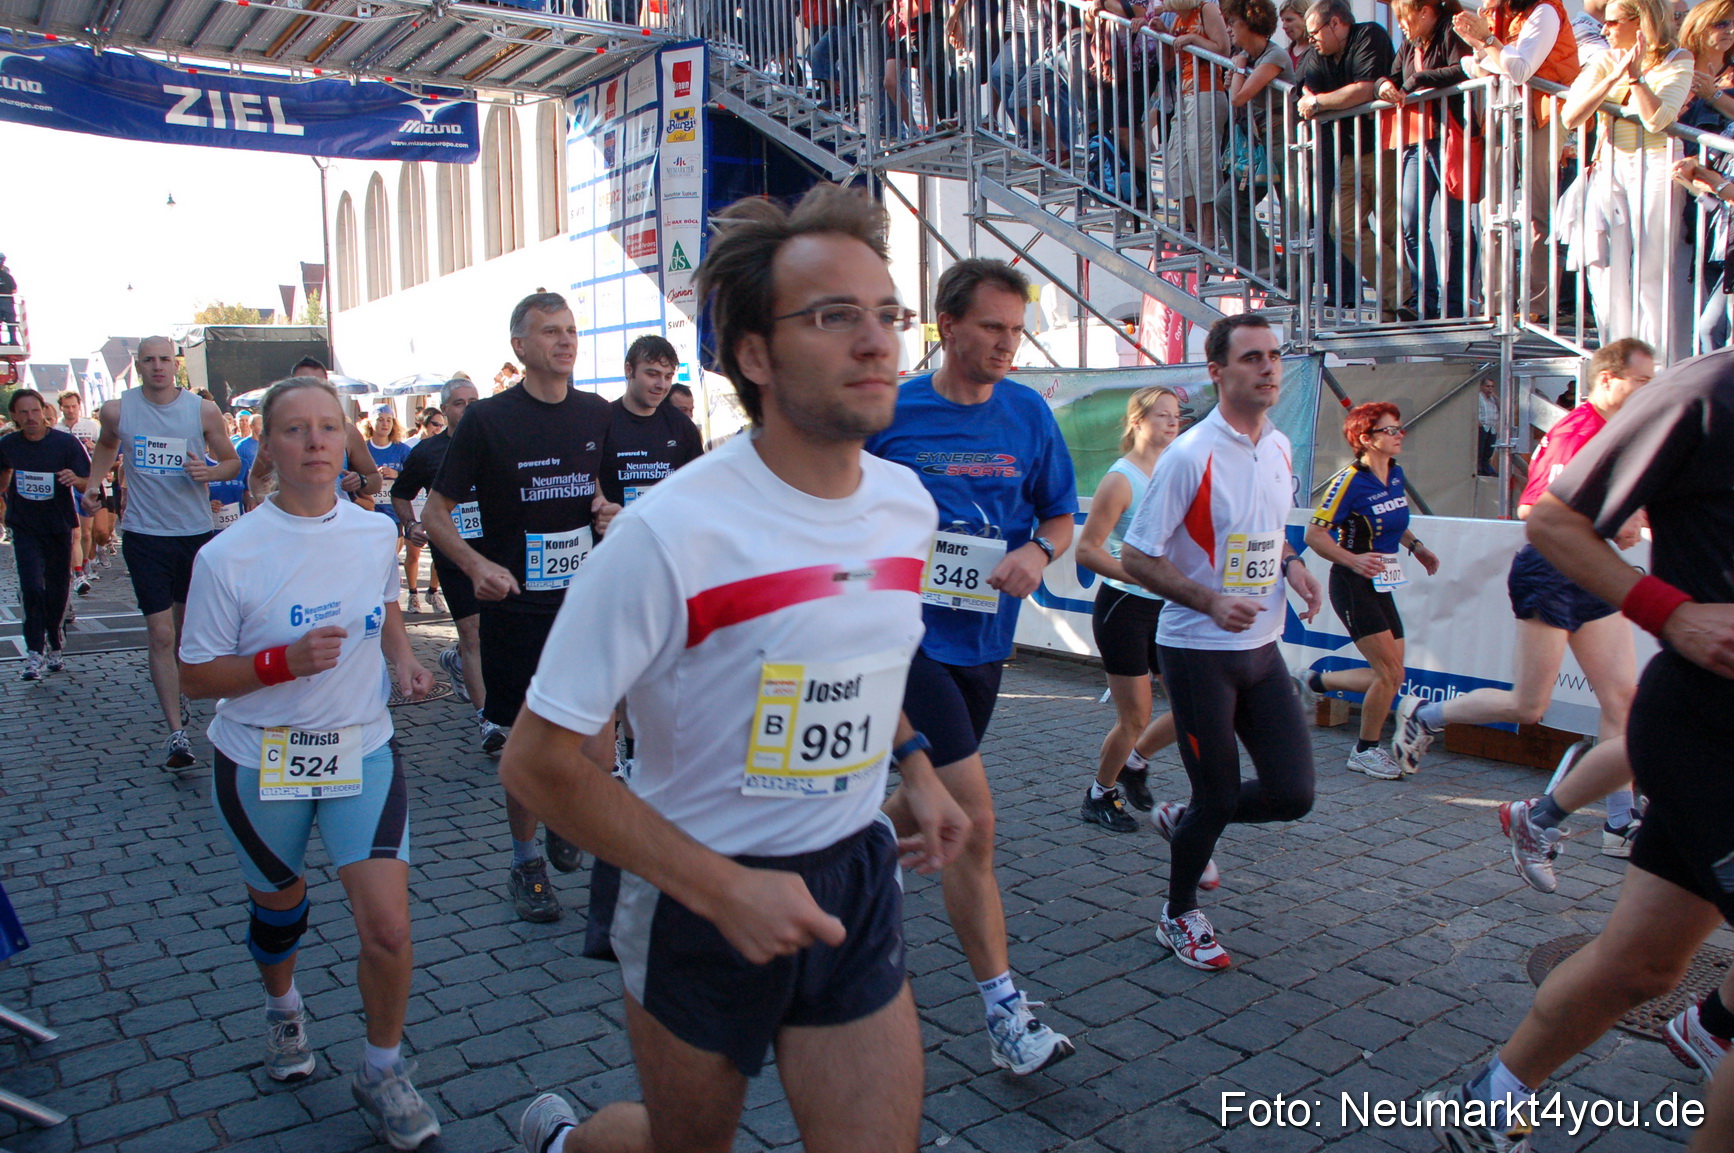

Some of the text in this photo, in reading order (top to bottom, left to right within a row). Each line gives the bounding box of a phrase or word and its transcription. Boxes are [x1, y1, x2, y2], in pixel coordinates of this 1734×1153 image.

[163, 84, 304, 136] ZIEL
[391, 140, 469, 149] www.mizunoeurope.com
[147, 440, 168, 449] Peter
[148, 452, 183, 466] 3179
[617, 450, 641, 458] powered
[916, 452, 997, 463] SYNERGY
[517, 457, 561, 470] powered by
[626, 461, 671, 471] Neumarkter
[946, 465, 1016, 478] SPORTS
[532, 472, 591, 488] Neumarkter
[25, 483, 52, 494] 2369
[520, 481, 596, 502] Lammsbräu
[1367, 491, 1389, 502] TEAM
[219, 513, 239, 524] 3533
[545, 536, 579, 550] Konrad
[936, 539, 969, 557] Marc
[1246, 540, 1275, 552] Jürgen
[530, 555, 539, 565] B
[1230, 557, 1240, 568] B
[1246, 558, 1275, 579] 632
[933, 564, 979, 590] 348
[304, 601, 342, 615] Neumarkter
[314, 607, 342, 622] Stadtlauf
[290, 604, 311, 627] 6.
[804, 673, 864, 703] Josef
[765, 714, 784, 735] B
[290, 731, 340, 746] Christa
[800, 713, 871, 762] 981
[267, 749, 279, 762] C
[289, 755, 339, 777] 524
[323, 784, 361, 793] PFLEIDERER
